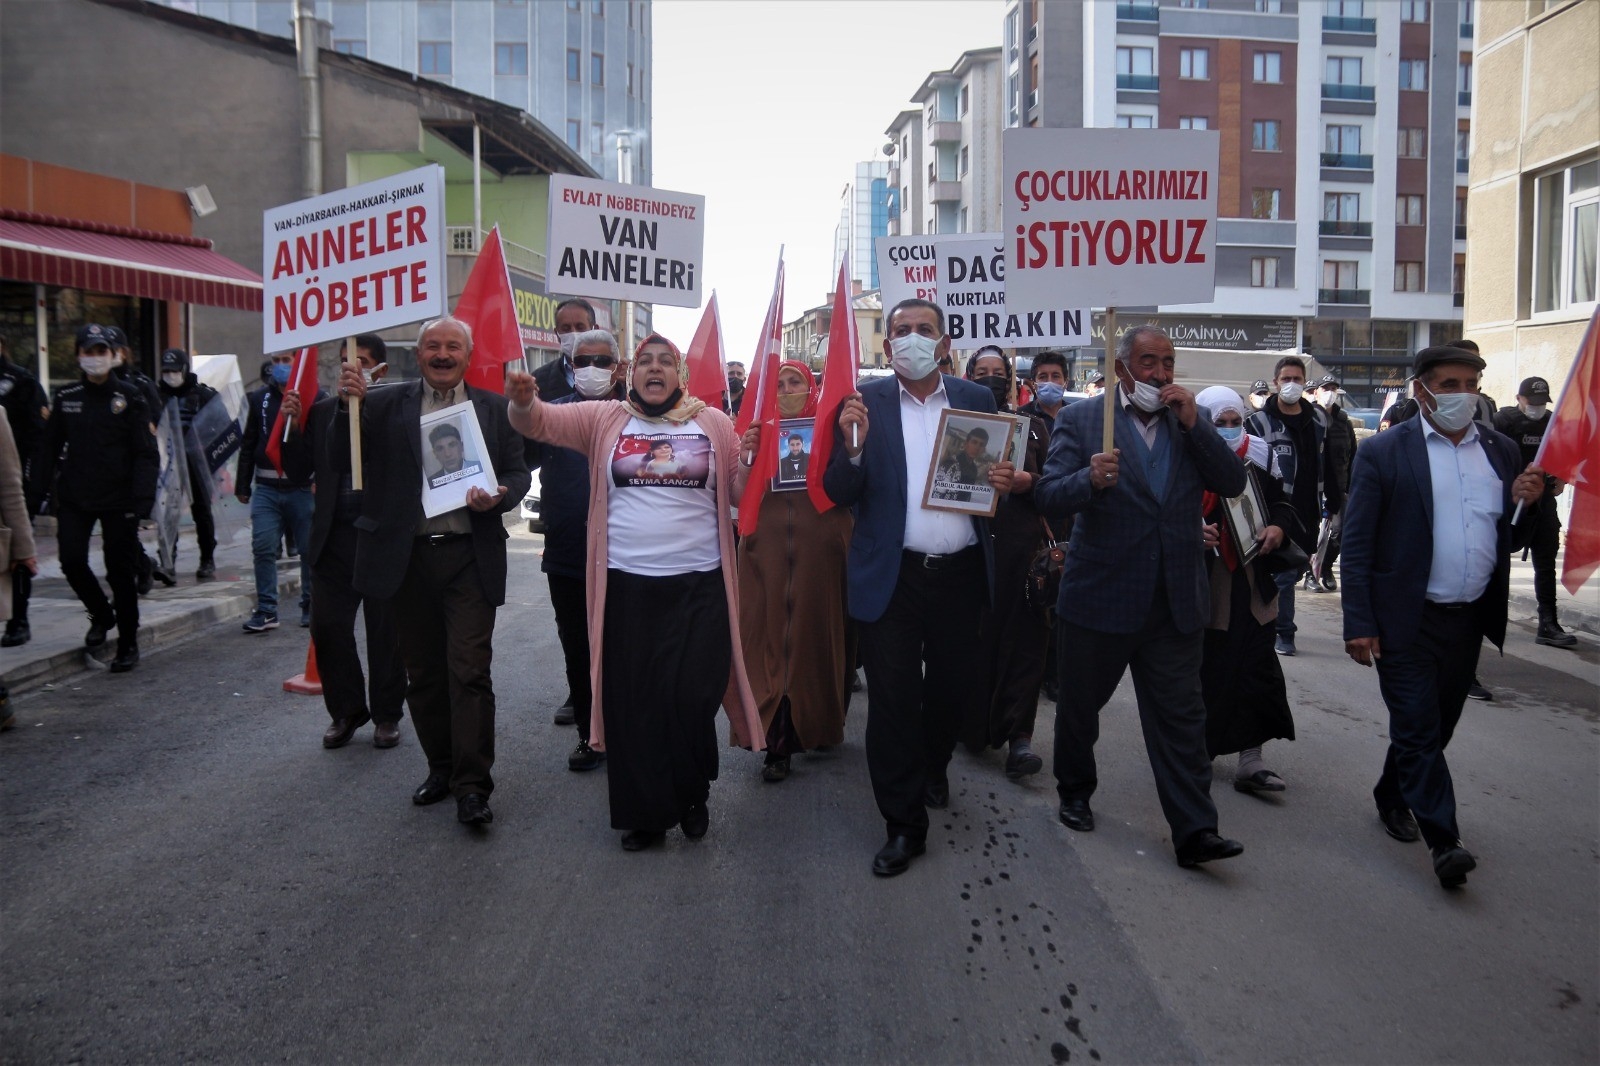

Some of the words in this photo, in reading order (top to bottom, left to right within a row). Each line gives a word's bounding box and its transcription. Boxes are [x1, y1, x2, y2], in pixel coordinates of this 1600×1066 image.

[563, 187, 603, 207] EVLAT
[1014, 169, 1208, 212] ÇOCUKLARIMIZI
[272, 205, 428, 280] ANNELER
[599, 214, 658, 251] VAN
[274, 275, 428, 334] NÖBETTE
[948, 310, 1082, 340] BIRAKIN
[662, 478, 700, 486] SANCAR
